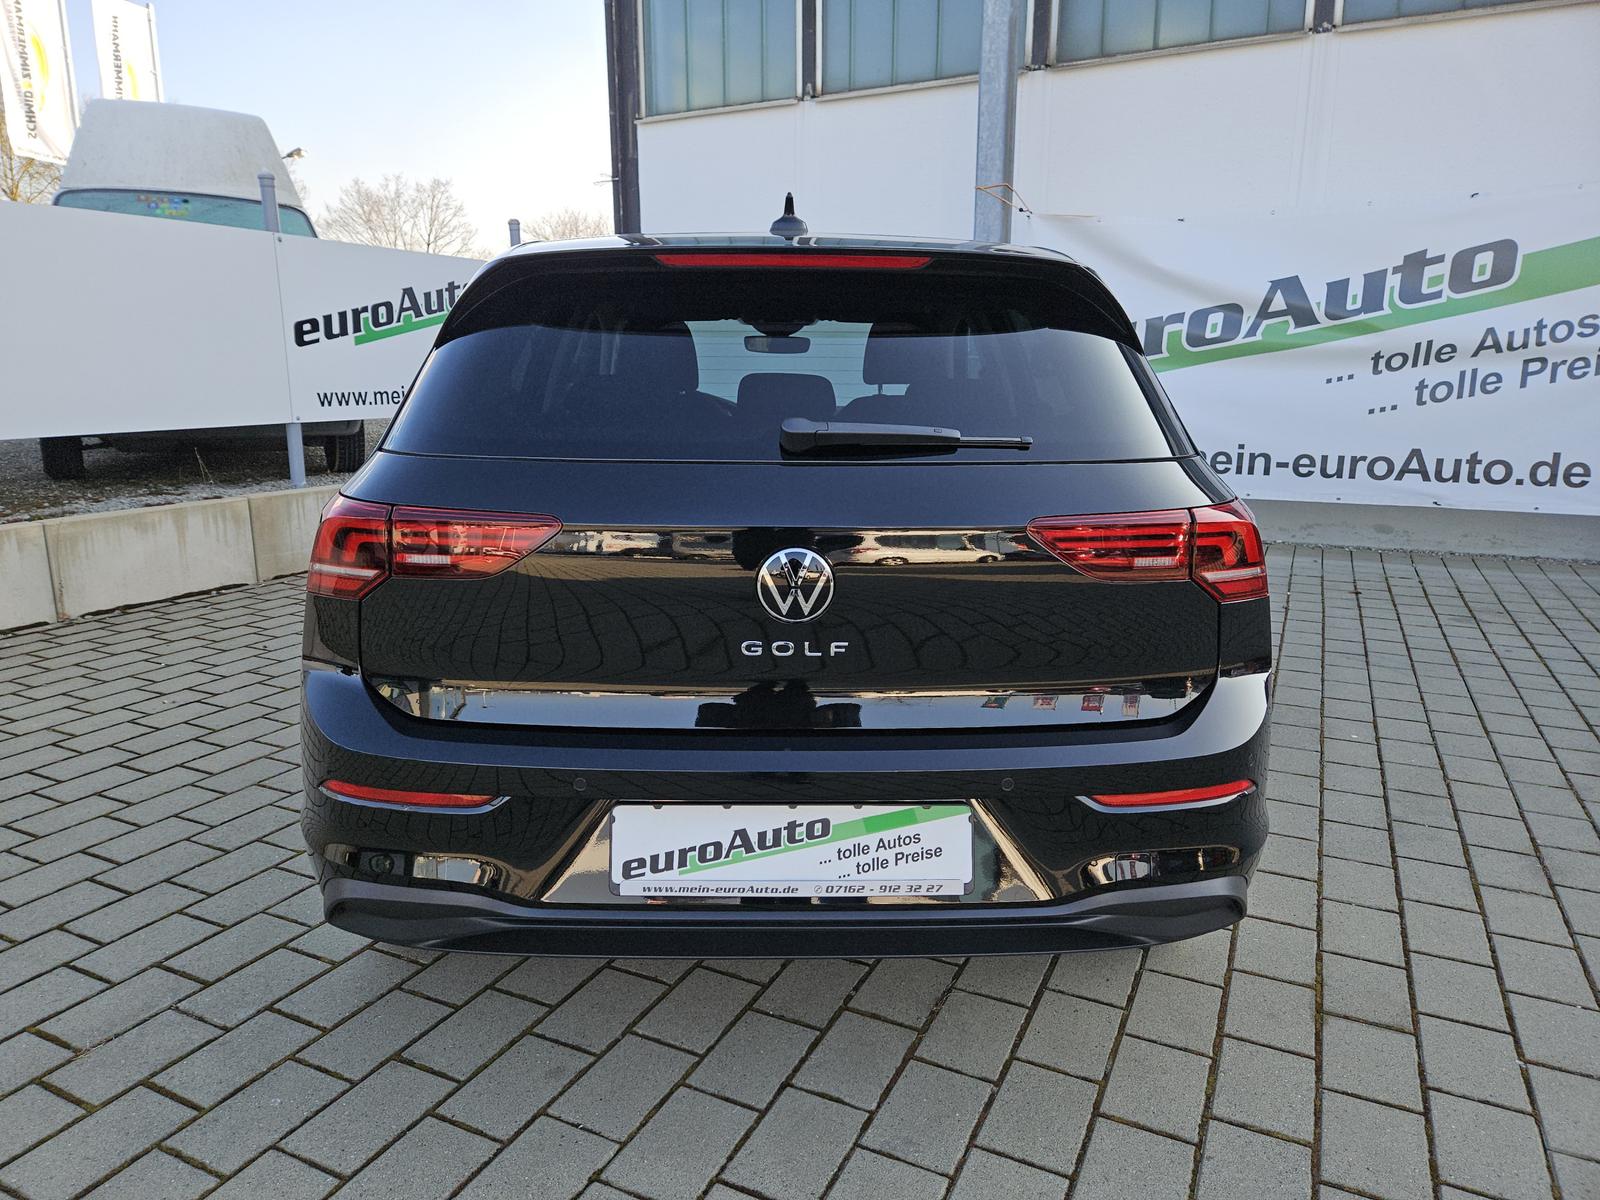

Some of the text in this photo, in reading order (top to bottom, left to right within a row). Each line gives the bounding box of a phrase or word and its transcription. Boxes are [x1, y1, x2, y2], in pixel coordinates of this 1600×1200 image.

[293, 281, 468, 348] euroAut
[1131, 239, 1519, 357] roAuto
[1371, 339, 1458, 375] tolle
[1470, 314, 1600, 358] Autos
[1415, 368, 1503, 406] tolle
[1200, 443, 1592, 489] ein-euroAuto.de
[741, 640, 849, 657] GOLF
[622, 817, 831, 880] euroAuto
[837, 842, 870, 861] tolle
[875, 833, 921, 852] Autos
[856, 857, 889, 875] tolle
[895, 846, 943, 866] Preise
[642, 884, 799, 895] www.mein-euroAuto.de
[825, 885, 865, 894] 07162
[879, 885, 901, 893] 912
[905, 884, 922, 893] 32
[926, 884, 943, 893] 27
